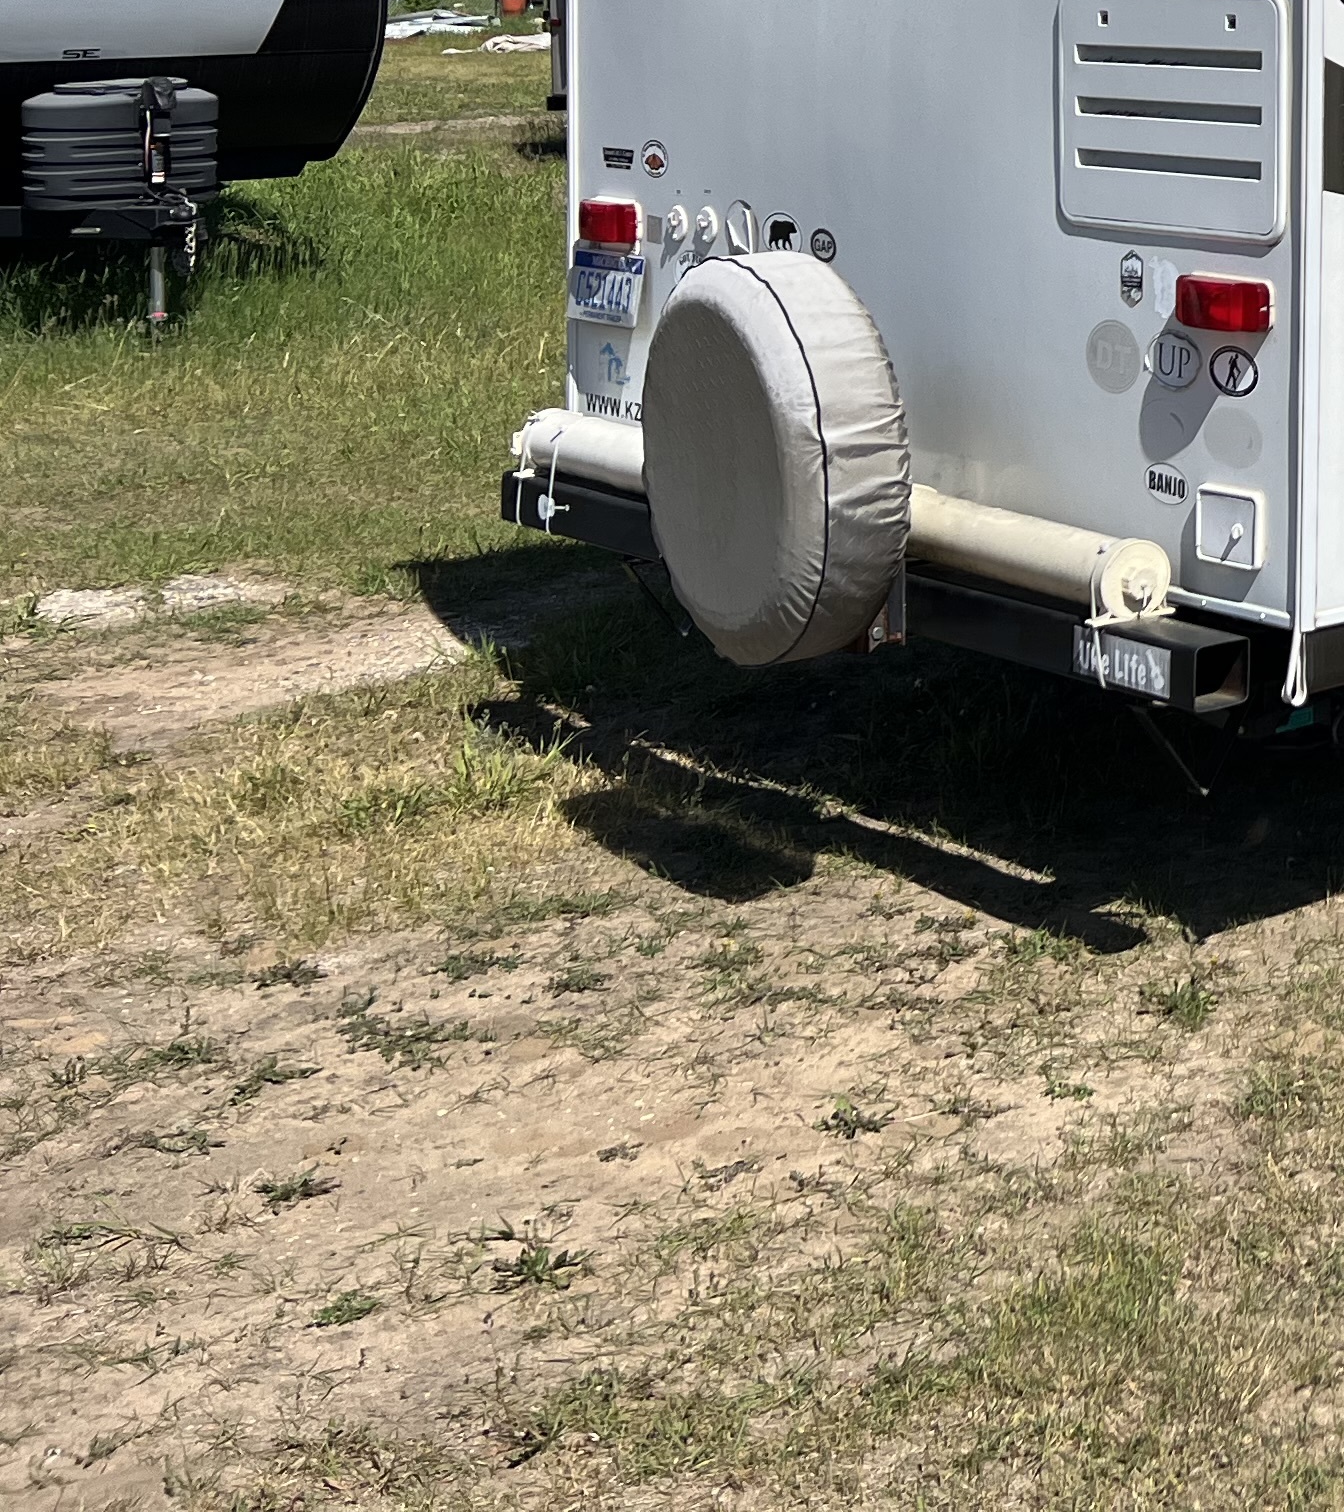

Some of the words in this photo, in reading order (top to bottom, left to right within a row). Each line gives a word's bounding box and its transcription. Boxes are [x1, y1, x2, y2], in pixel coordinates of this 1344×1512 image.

[61, 48, 101, 59] SE
[813, 238, 833, 254] GAP
[1158, 342, 1191, 379] UP
[1148, 469, 1186, 499] BANJO
